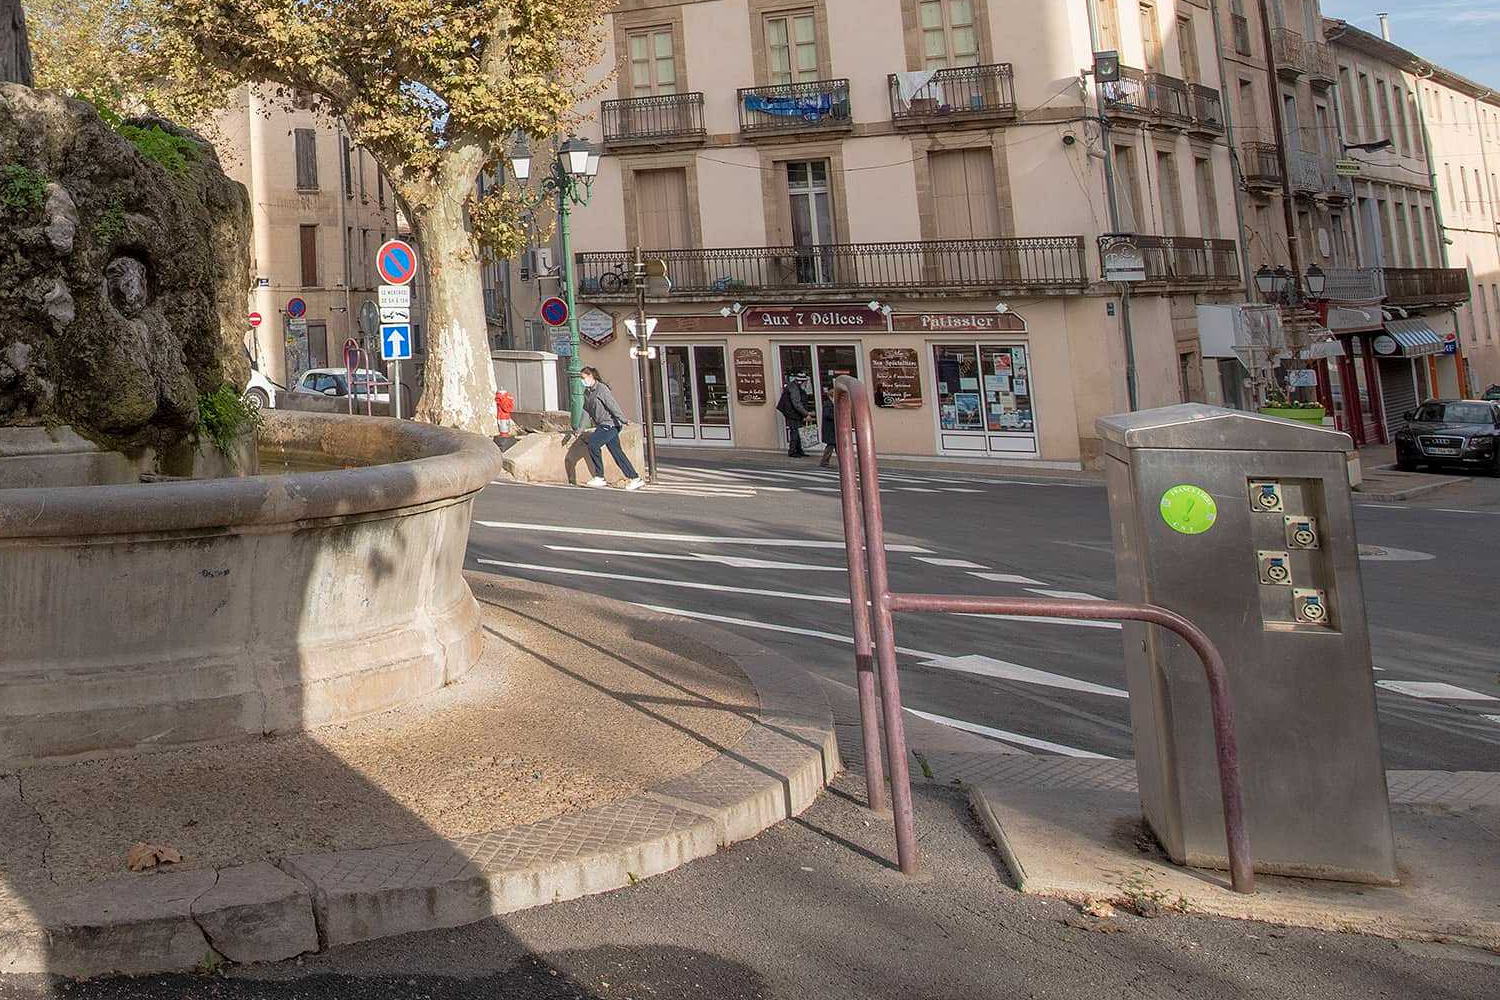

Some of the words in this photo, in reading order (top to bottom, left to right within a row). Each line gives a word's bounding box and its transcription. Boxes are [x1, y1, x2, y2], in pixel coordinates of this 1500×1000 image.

[761, 312, 790, 326] Aux
[795, 312, 805, 325] 7
[810, 312, 864, 325] Délices
